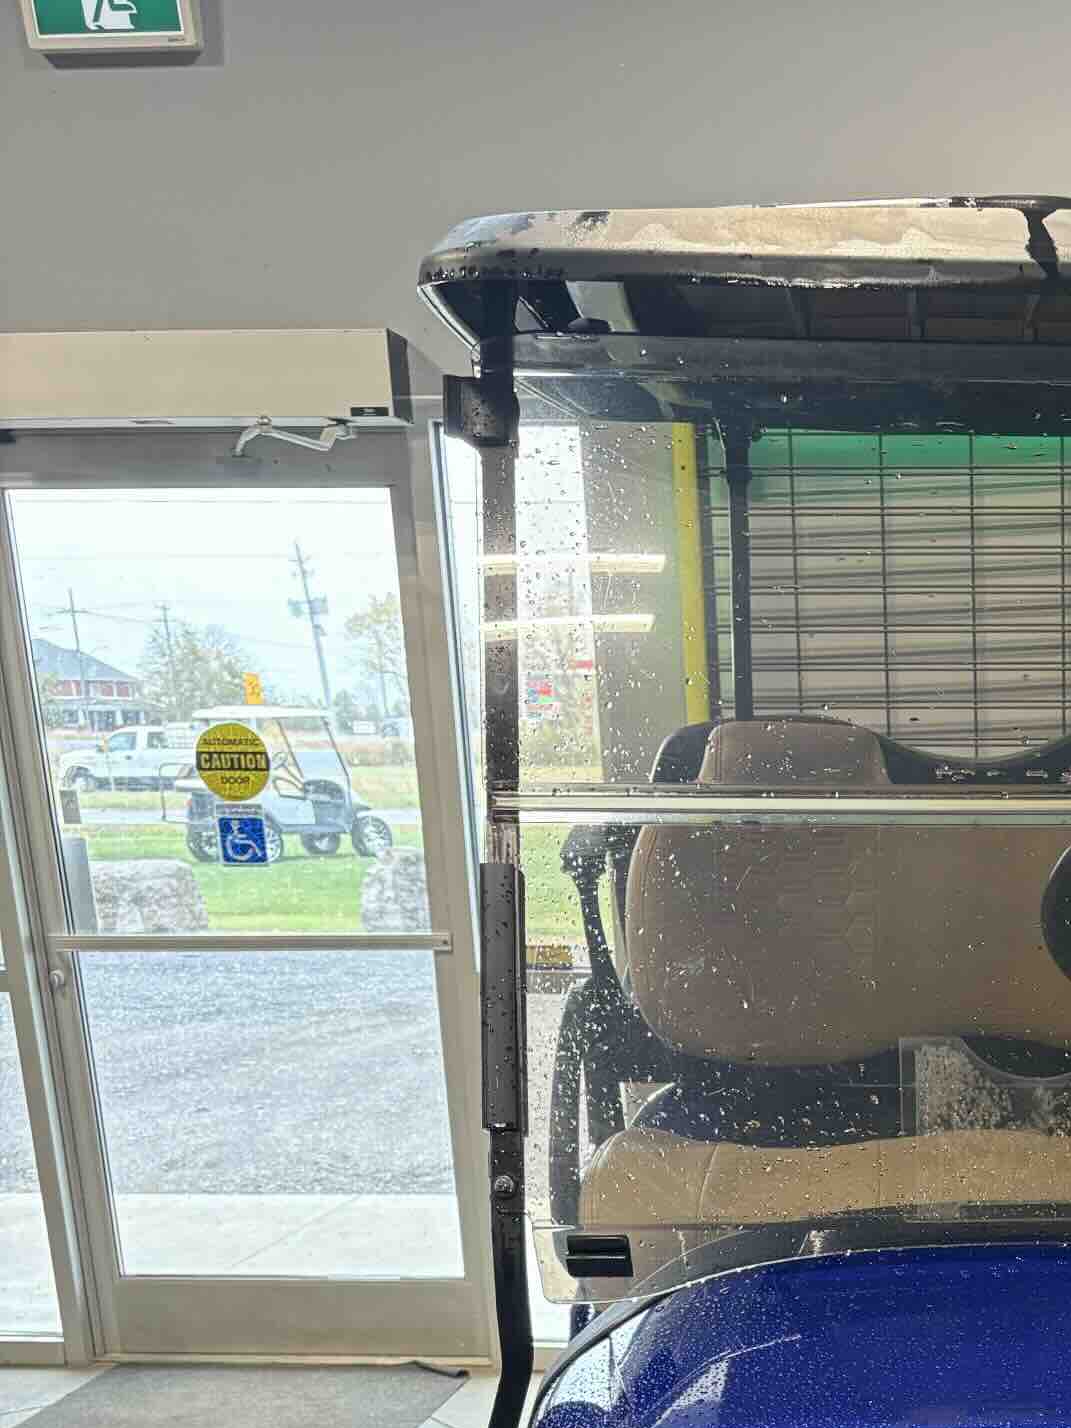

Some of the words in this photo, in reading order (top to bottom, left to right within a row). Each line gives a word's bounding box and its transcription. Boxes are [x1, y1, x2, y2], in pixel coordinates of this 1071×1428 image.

[201, 737, 260, 745] AUTOMATIC
[200, 753, 267, 769] CAUTION
[220, 776, 250, 784] DOOR
